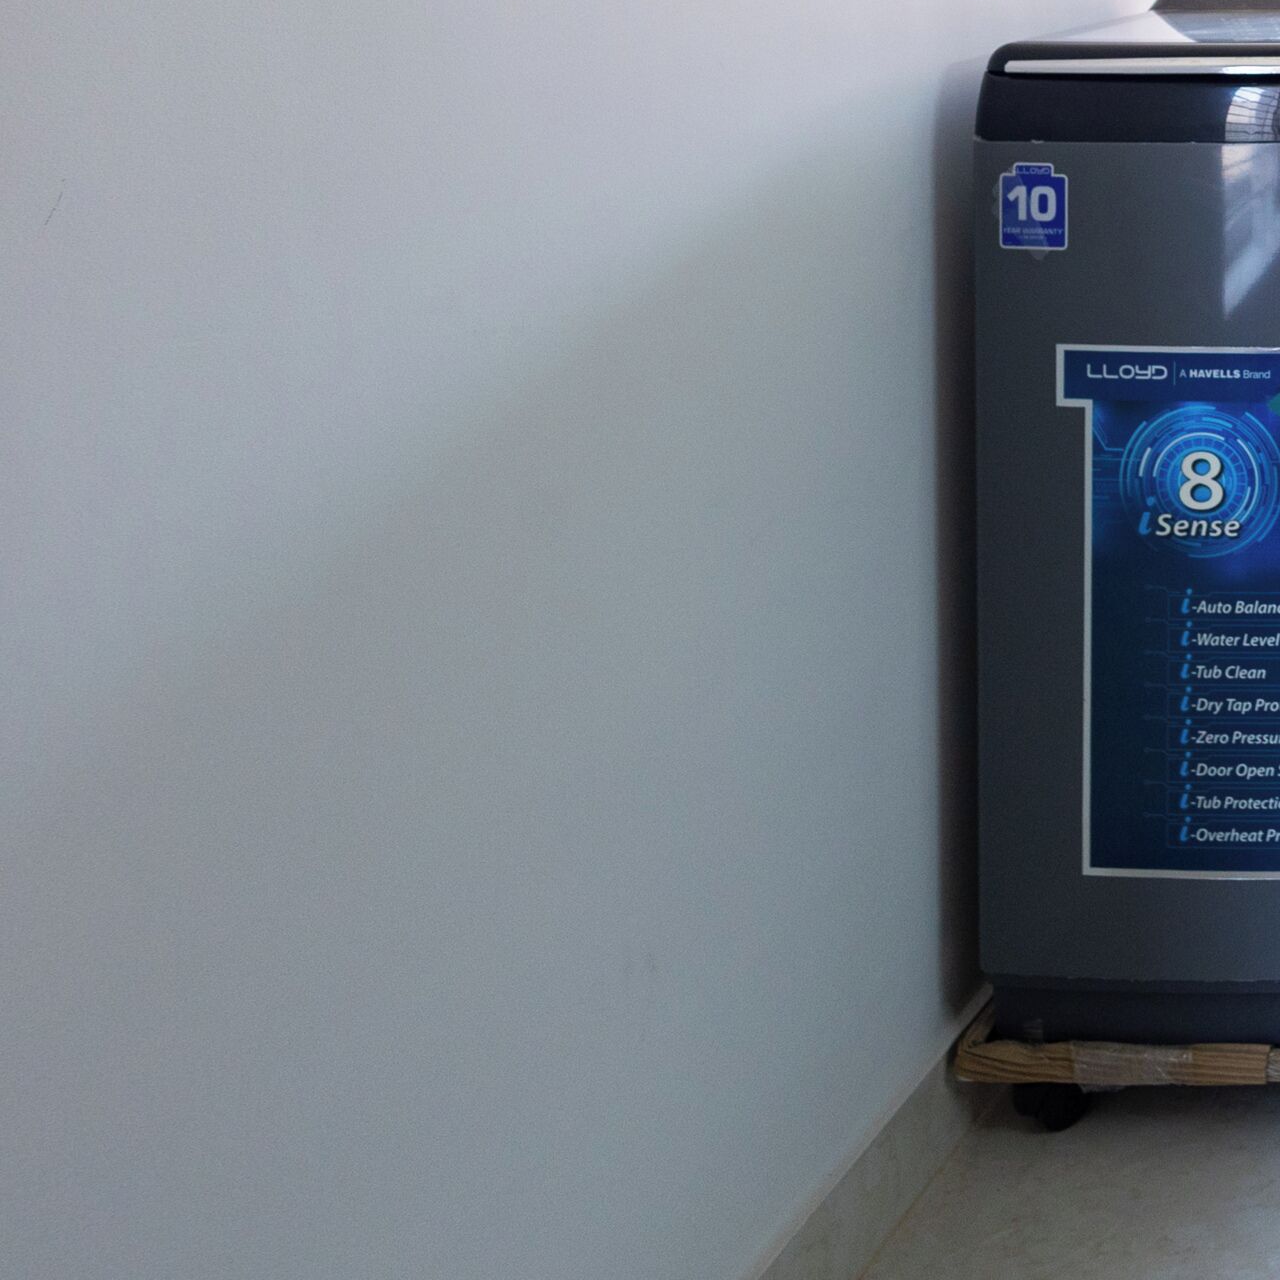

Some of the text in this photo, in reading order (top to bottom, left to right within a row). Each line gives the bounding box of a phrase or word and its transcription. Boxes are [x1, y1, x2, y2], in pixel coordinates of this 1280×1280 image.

[1007, 185, 1057, 222] 10
[1086, 363, 1271, 380] LLOYD A HAVELLS Brand
[1178, 450, 1226, 512] 8
[1155, 514, 1241, 538] Sense
[1243, 632, 1280, 647] Level
[1225, 665, 1266, 679] Clean
[1226, 698, 1252, 714] Tap
[1235, 763, 1276, 780] Open
